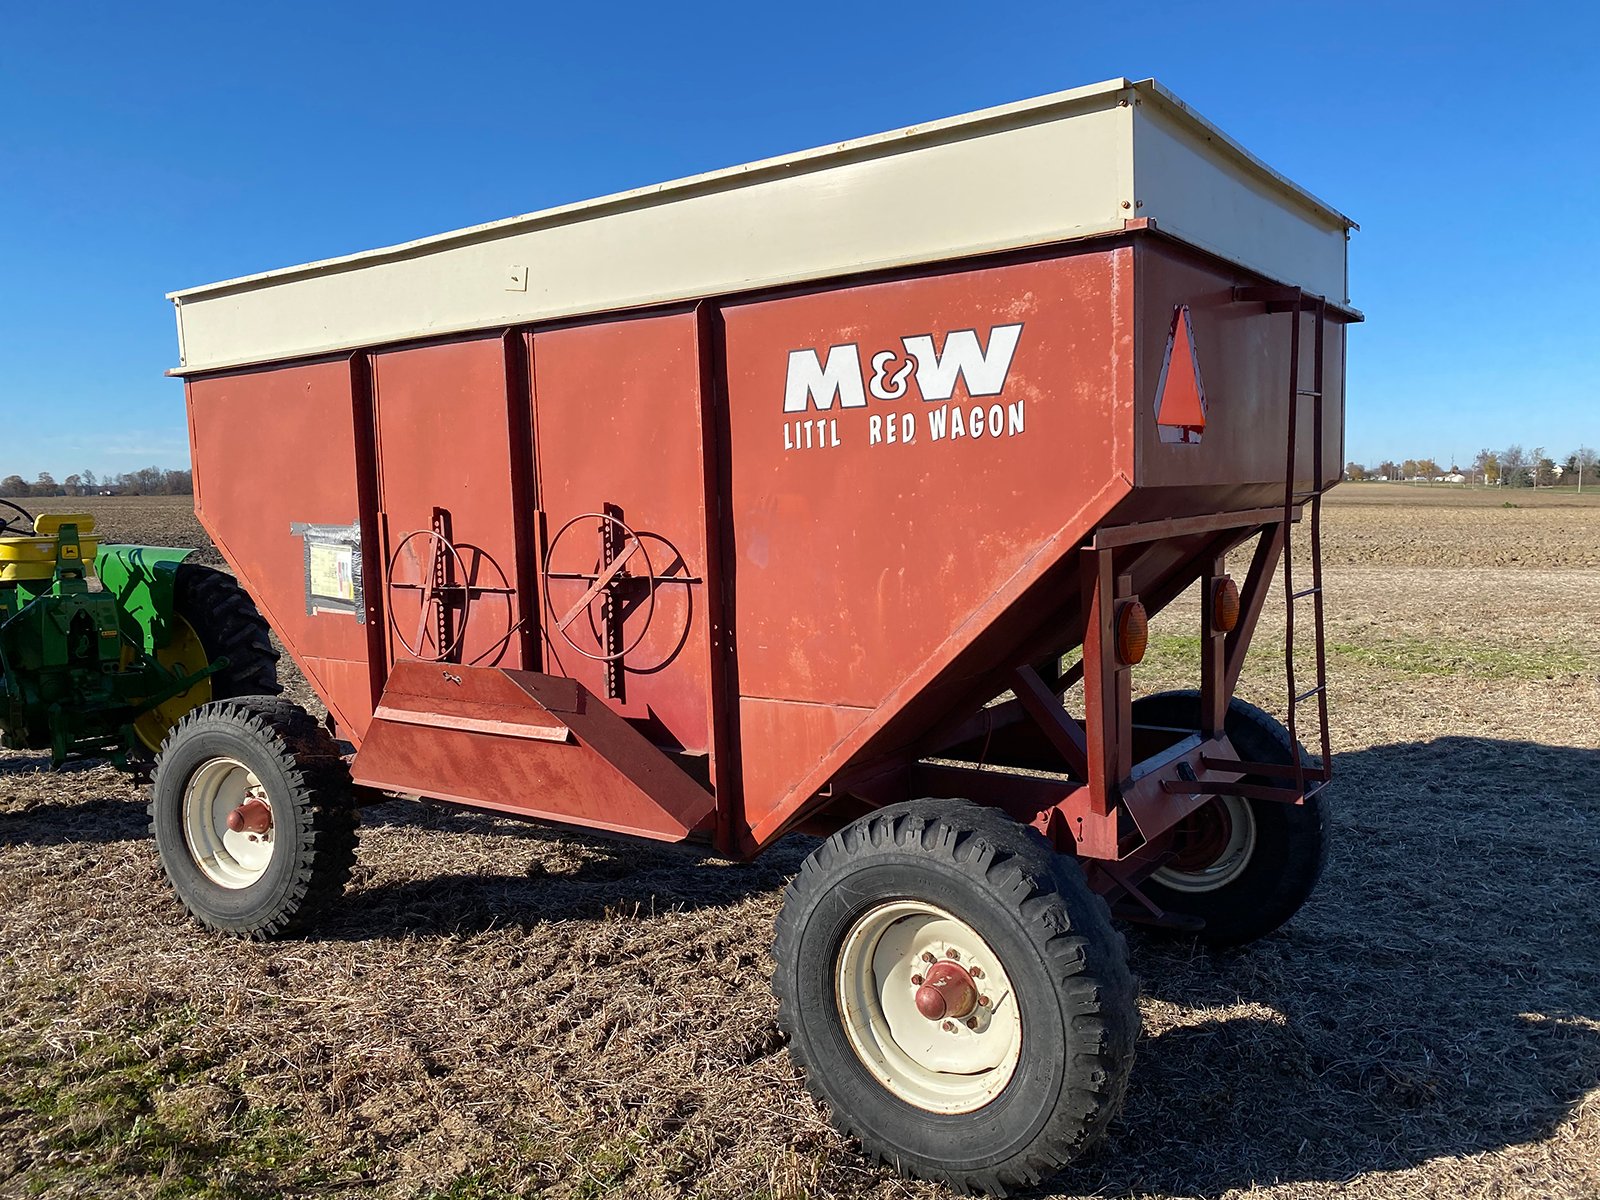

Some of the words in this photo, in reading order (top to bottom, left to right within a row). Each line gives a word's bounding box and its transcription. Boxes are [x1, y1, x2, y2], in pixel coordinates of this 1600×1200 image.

[783, 322, 1025, 413] M&W
[784, 418, 841, 450] LITTL
[869, 412, 916, 446] RED
[928, 400, 1025, 441] WAGON
